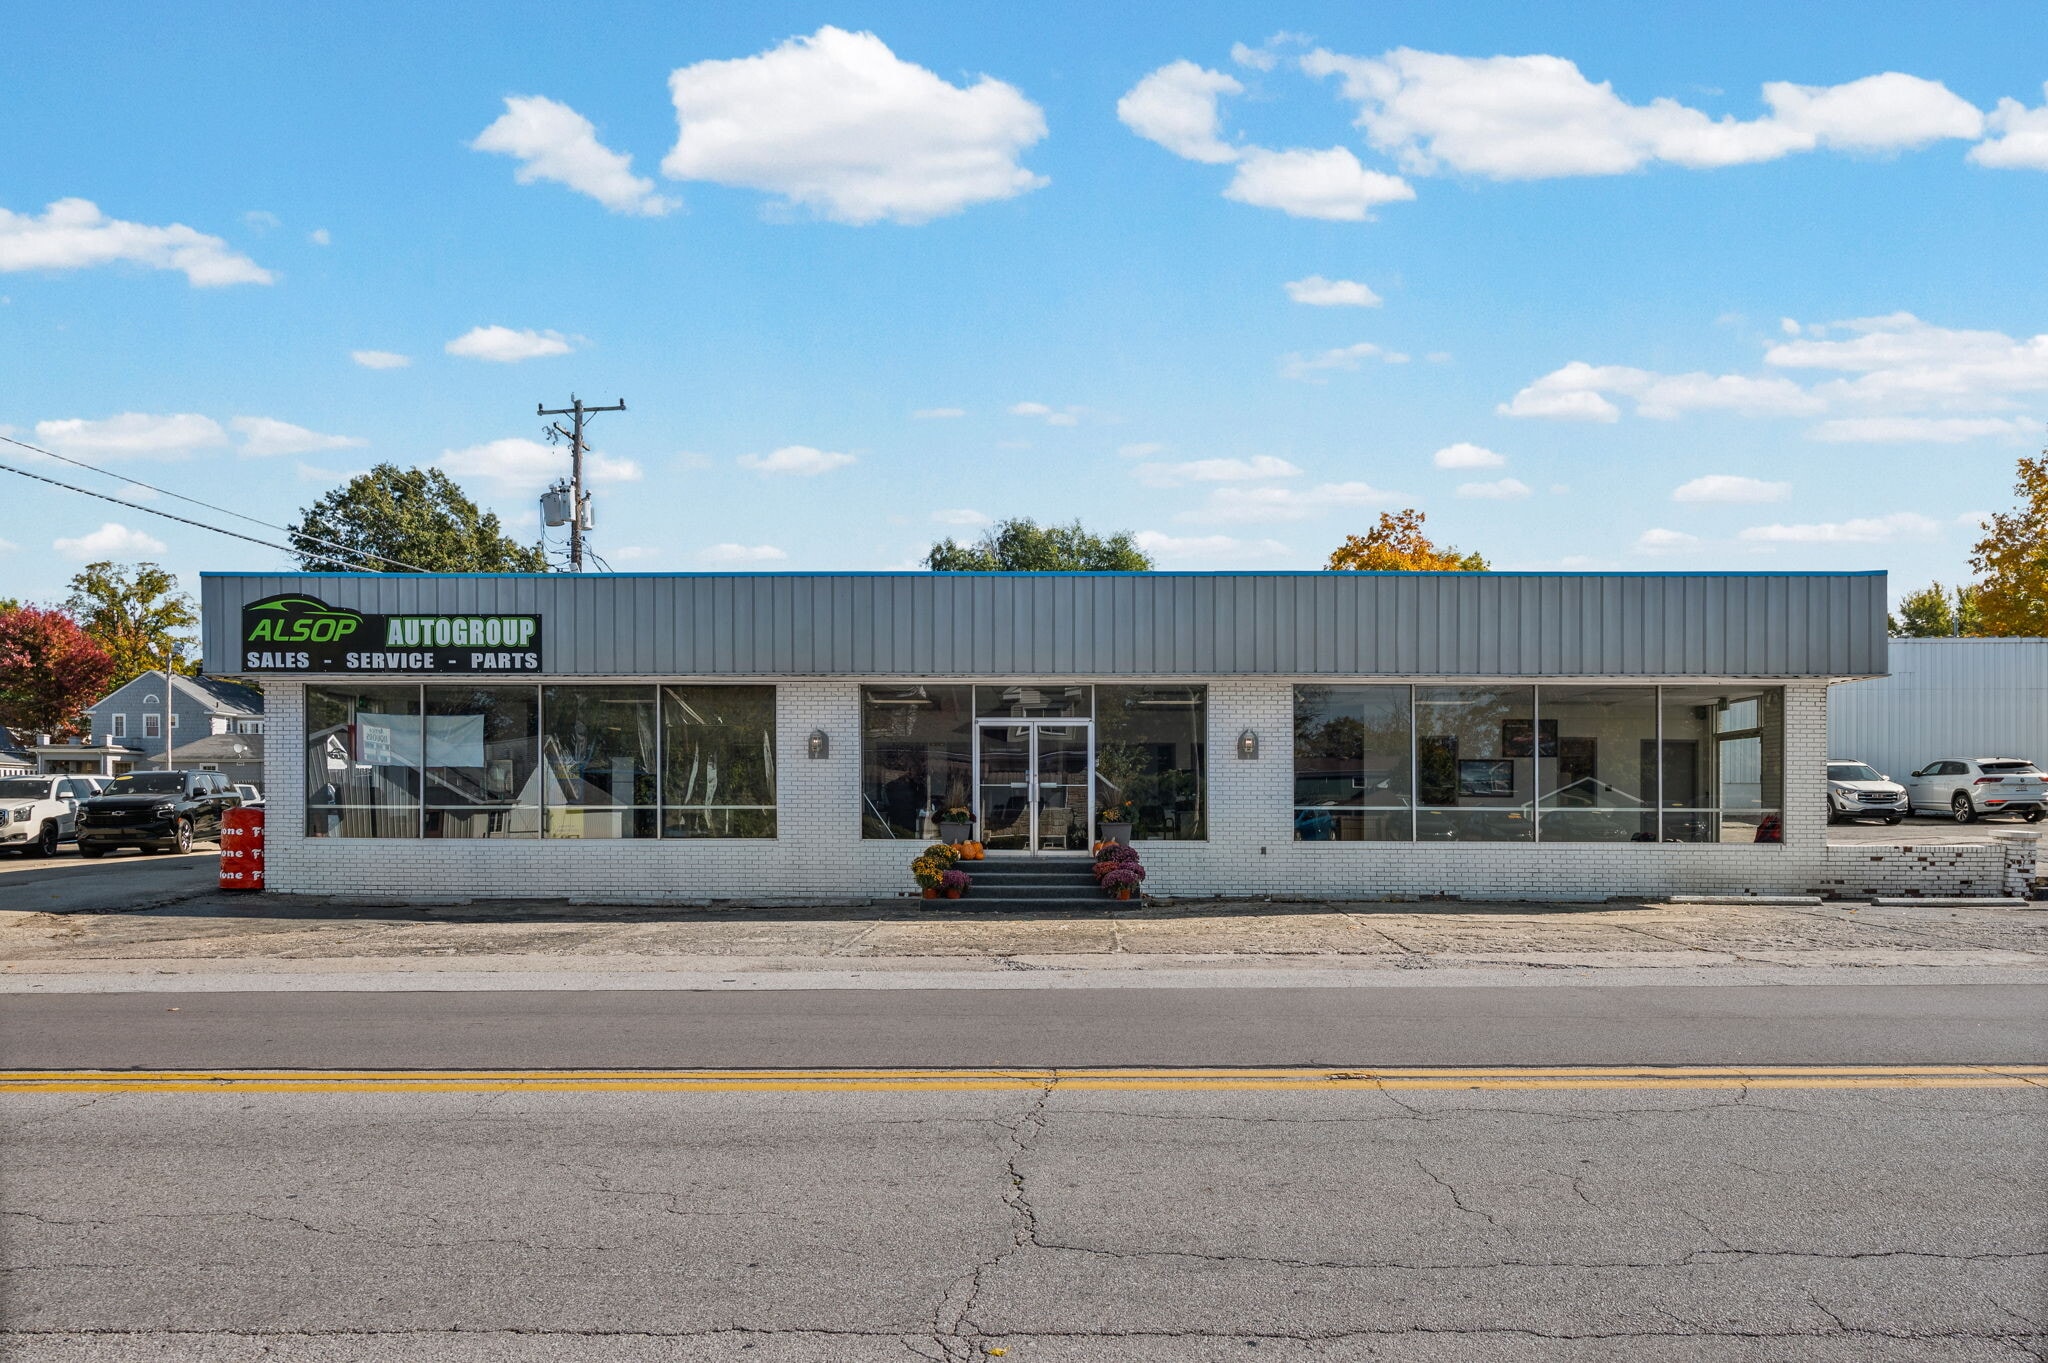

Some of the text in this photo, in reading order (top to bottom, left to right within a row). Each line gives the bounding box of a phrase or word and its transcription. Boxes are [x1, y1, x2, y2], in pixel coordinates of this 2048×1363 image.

[248, 619, 358, 642] ALSOP
[387, 617, 536, 647] AUTOGROUP
[247, 652, 310, 669] SALES
[346, 652, 434, 669] SERVICE
[471, 652, 538, 669] PARTS
